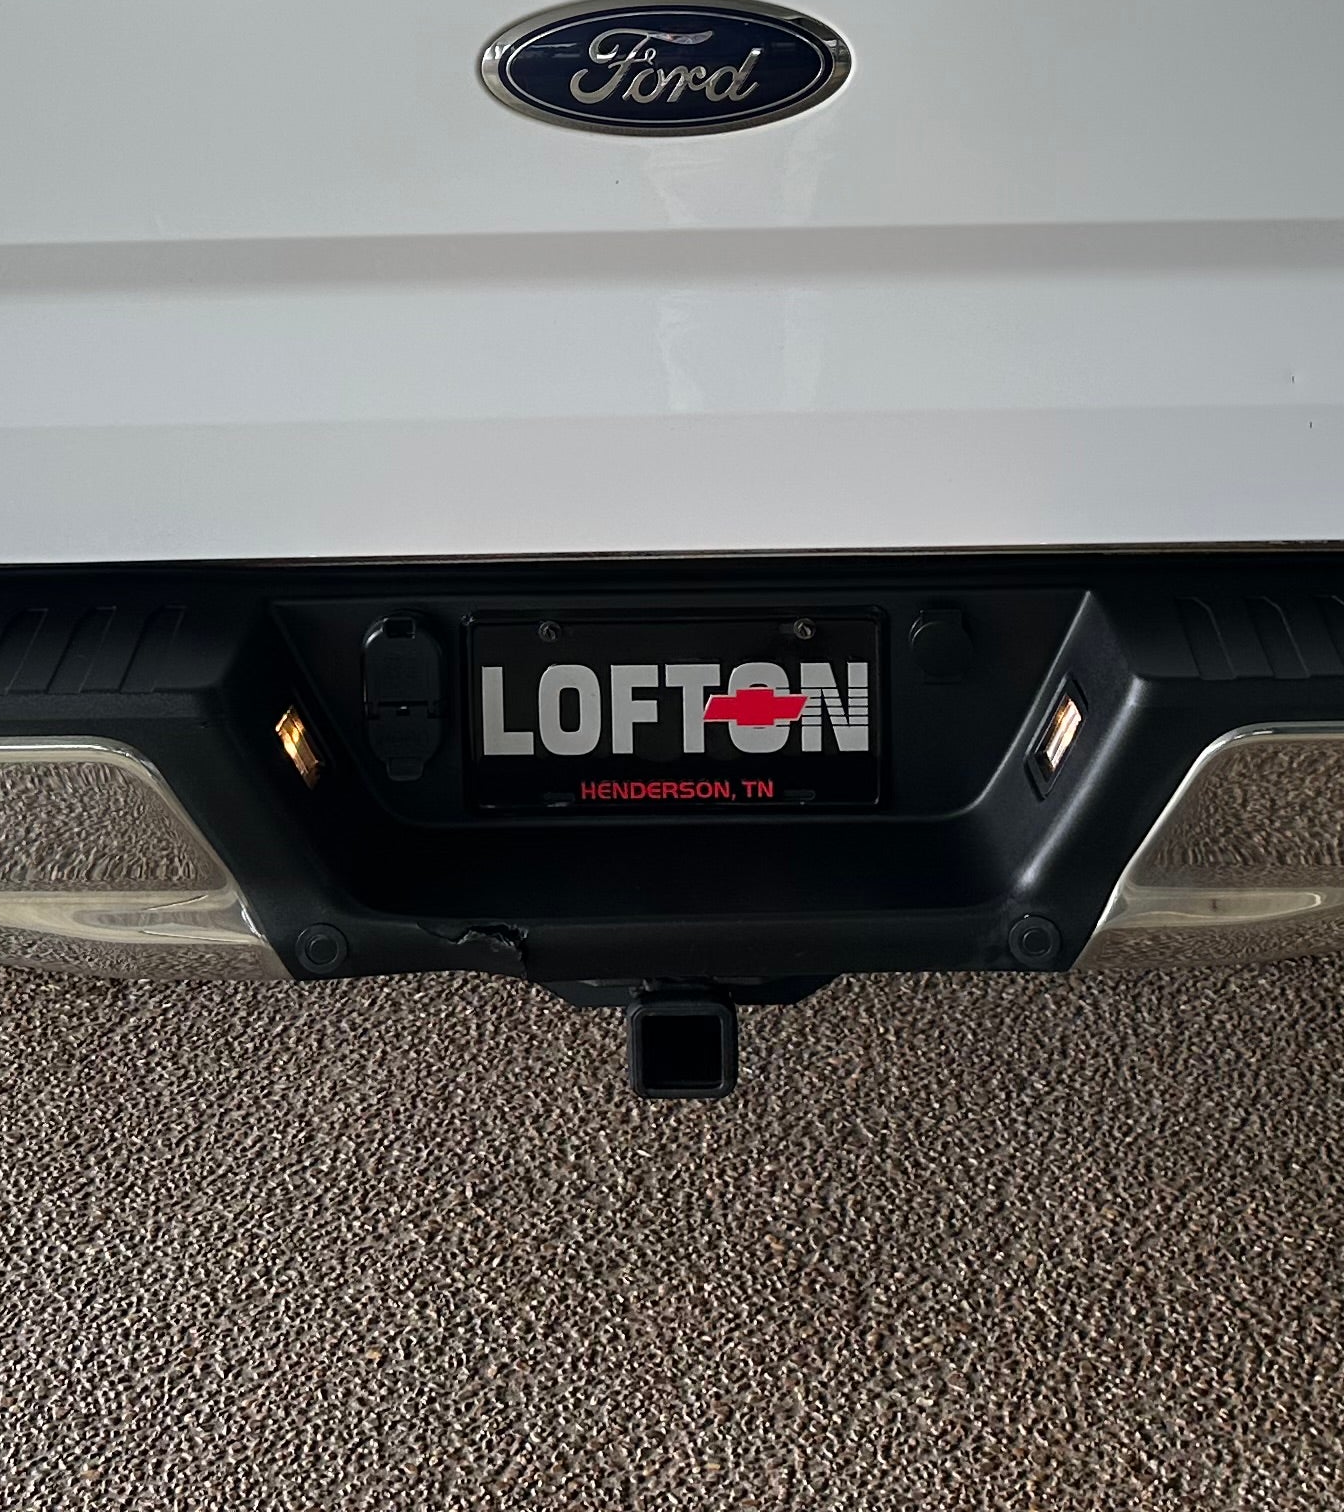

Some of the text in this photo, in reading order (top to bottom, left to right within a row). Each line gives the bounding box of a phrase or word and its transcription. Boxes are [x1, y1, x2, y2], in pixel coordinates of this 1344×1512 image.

[568, 28, 763, 104] Ford
[482, 662, 869, 755] LOFTON
[581, 780, 774, 800] HENDERSON, TN
